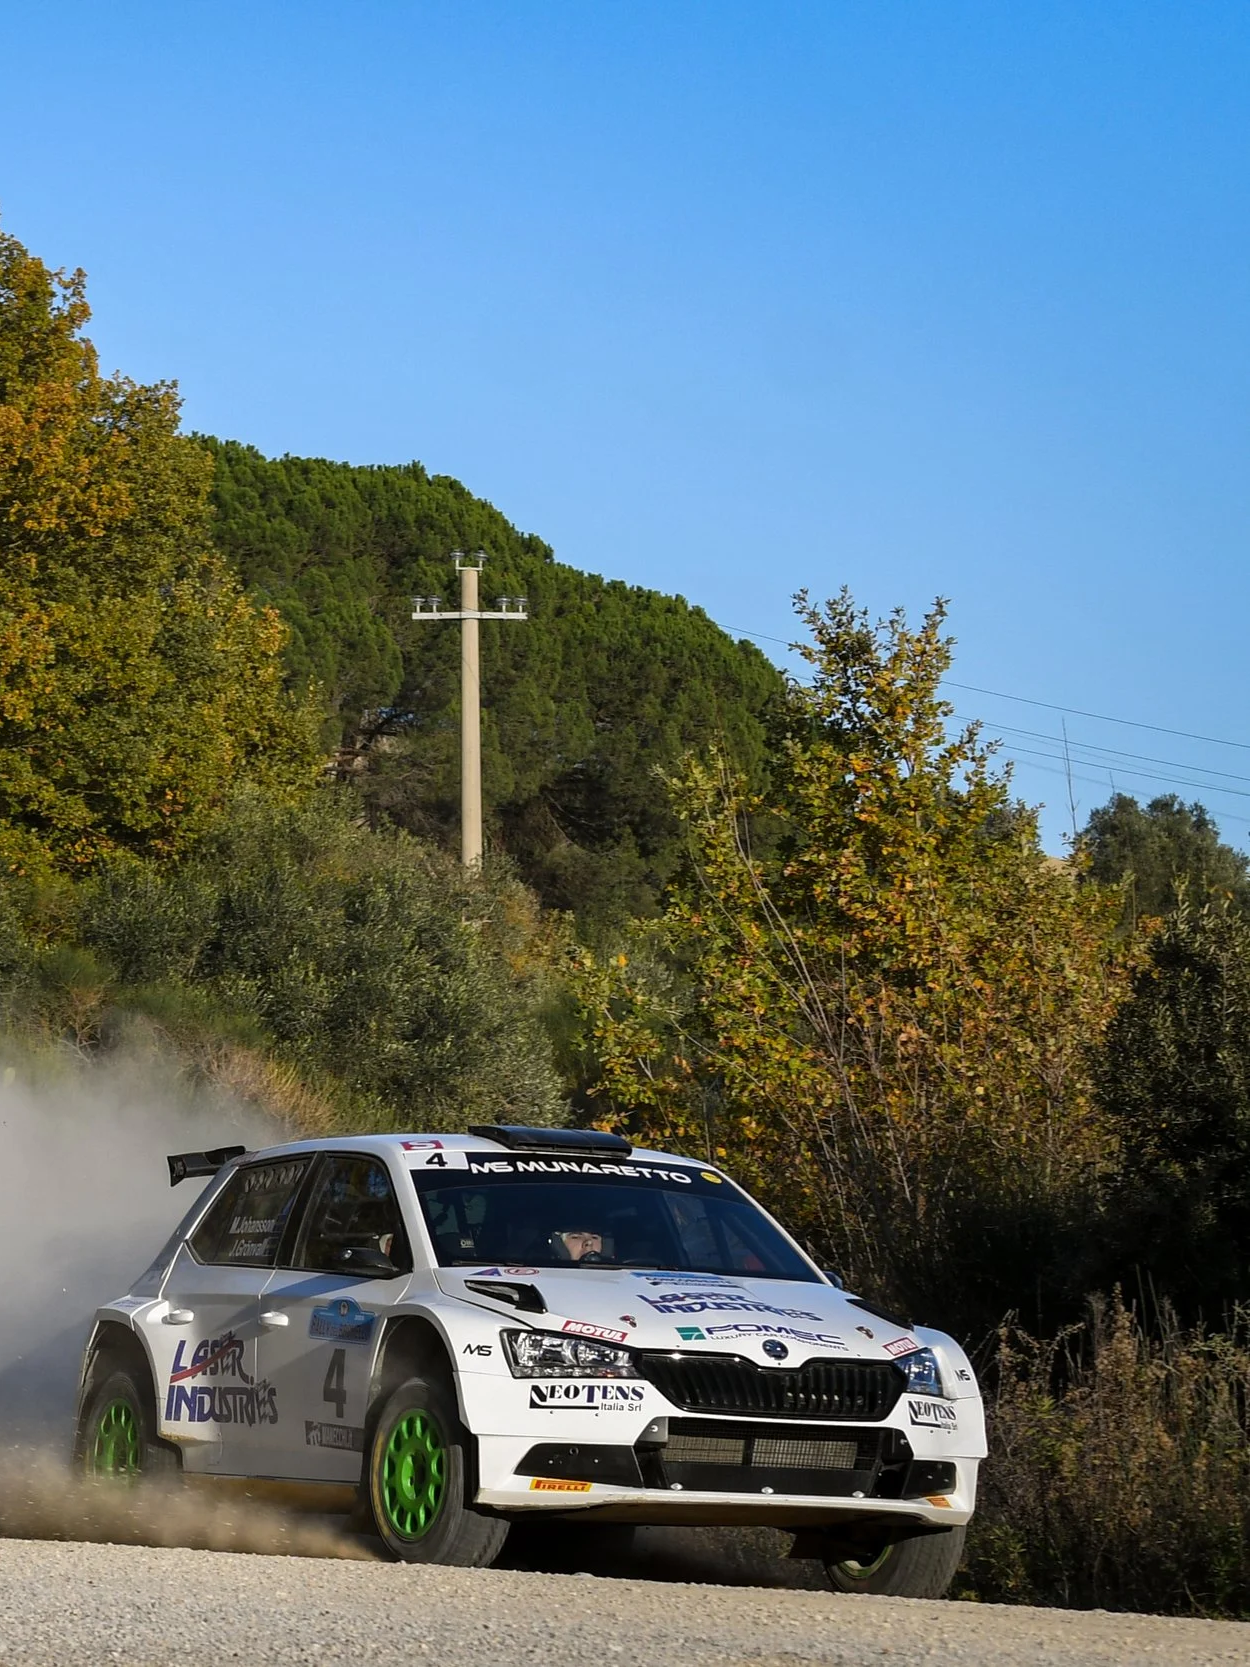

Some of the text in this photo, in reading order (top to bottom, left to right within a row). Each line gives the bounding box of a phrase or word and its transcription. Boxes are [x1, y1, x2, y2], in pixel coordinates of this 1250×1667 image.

[425, 1152, 449, 1167] 4
[470, 1161, 514, 1174] MS
[516, 1160, 692, 1184] MUNARETTO
[636, 1291, 764, 1305] LASER
[650, 1301, 824, 1321] INDUSTRIES
[565, 1322, 625, 1342] MOTUL
[705, 1323, 845, 1345] FOMEC
[710, 1332, 752, 1340] LUXURY
[780, 1334, 850, 1351] COMPONENTS
[462, 1343, 493, 1356] MS
[888, 1338, 916, 1355] MOTUL
[170, 1331, 251, 1385] LASER
[323, 1348, 347, 1418] 4
[955, 1369, 971, 1381] MS
[165, 1382, 279, 1427] INDUSTRIES
[530, 1385, 645, 1405] NEOTENS
[600, 1402, 642, 1412] Italia Srl
[908, 1401, 956, 1421] NEOTENS
[535, 1480, 588, 1491] PIRELLI
